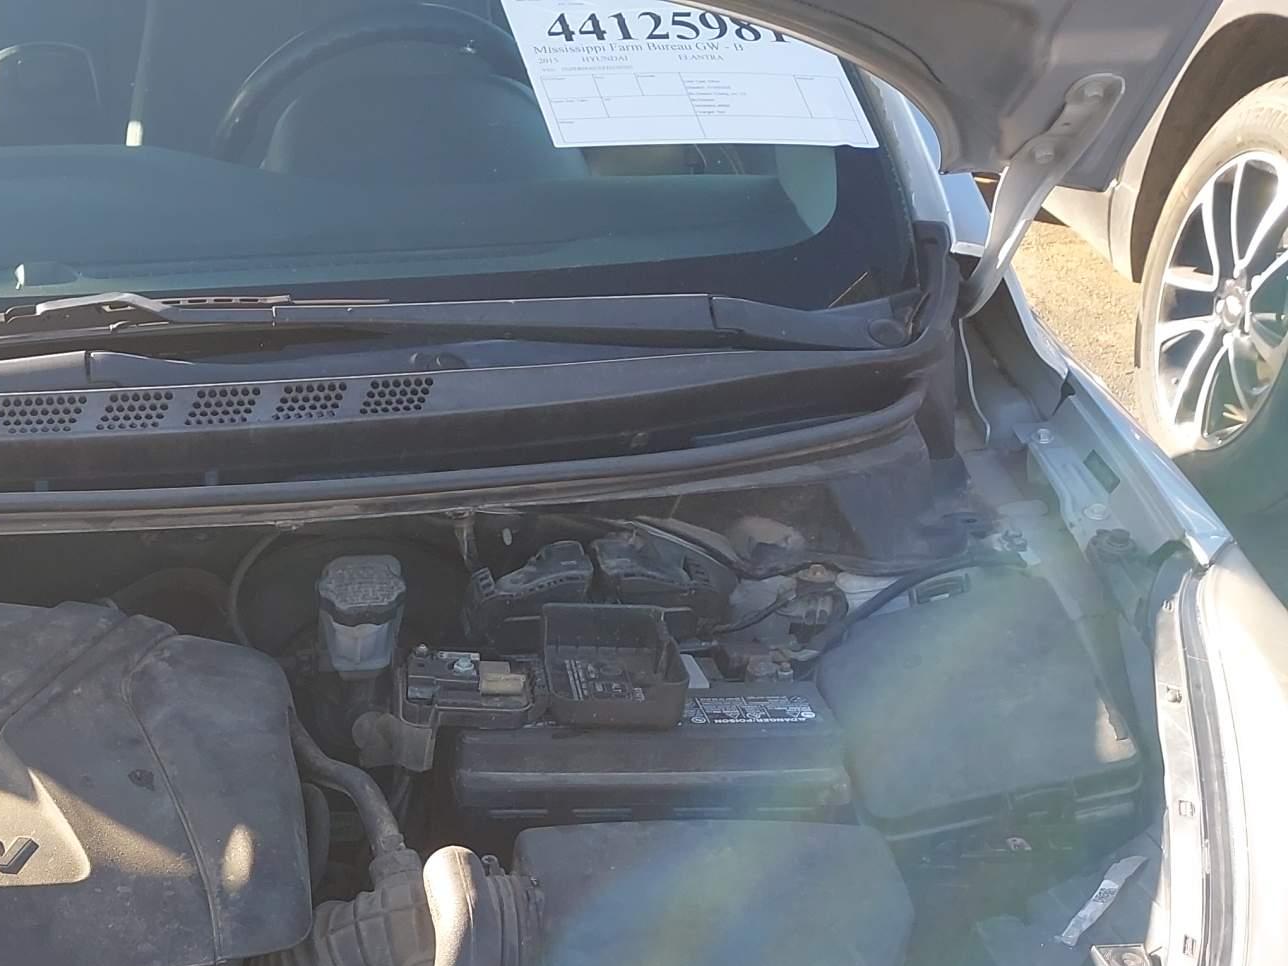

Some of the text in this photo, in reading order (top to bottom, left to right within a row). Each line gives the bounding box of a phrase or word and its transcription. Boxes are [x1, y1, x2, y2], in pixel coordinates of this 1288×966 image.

[534, 44, 606, 55] Mississippi
[610, 42, 643, 52] Farm
[646, 41, 692, 51] Bureau
[695, 41, 720, 51] GW
[581, 55, 629, 63] HYUNDAI
[678, 53, 724, 61] ELANTRA
